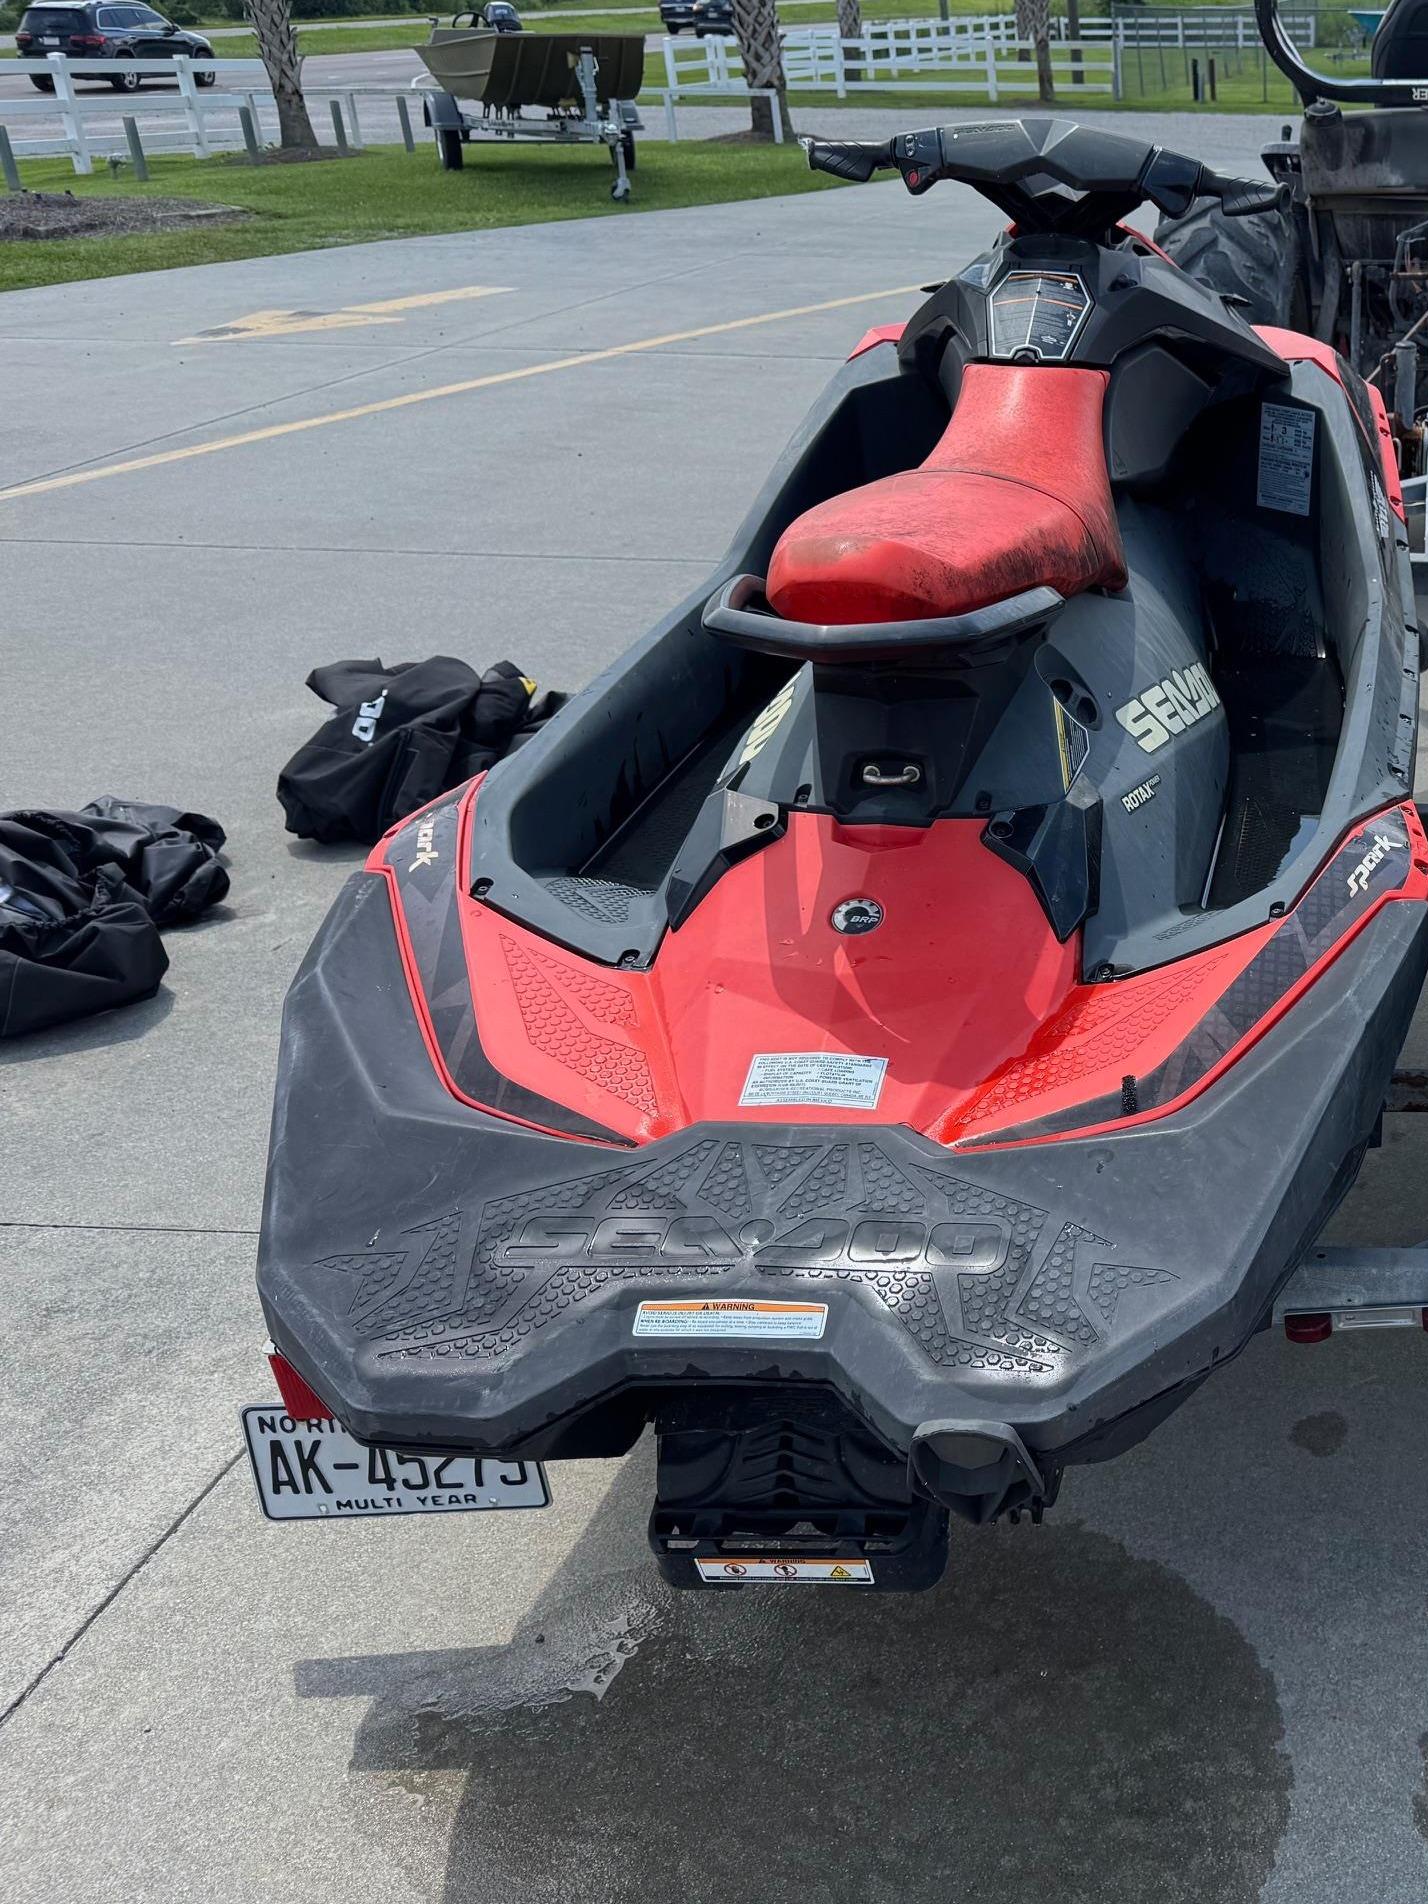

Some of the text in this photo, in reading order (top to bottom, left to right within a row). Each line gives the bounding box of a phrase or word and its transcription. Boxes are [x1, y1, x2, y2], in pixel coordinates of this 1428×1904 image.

[1121, 782, 1155, 812] ROTAX
[1346, 834, 1403, 899] spark
[850, 915, 879, 923] BRP
[711, 1302, 756, 1311] WARNING
[257, 1415, 347, 1434] NORT
[336, 1493, 478, 1511] MULTI YEAR
